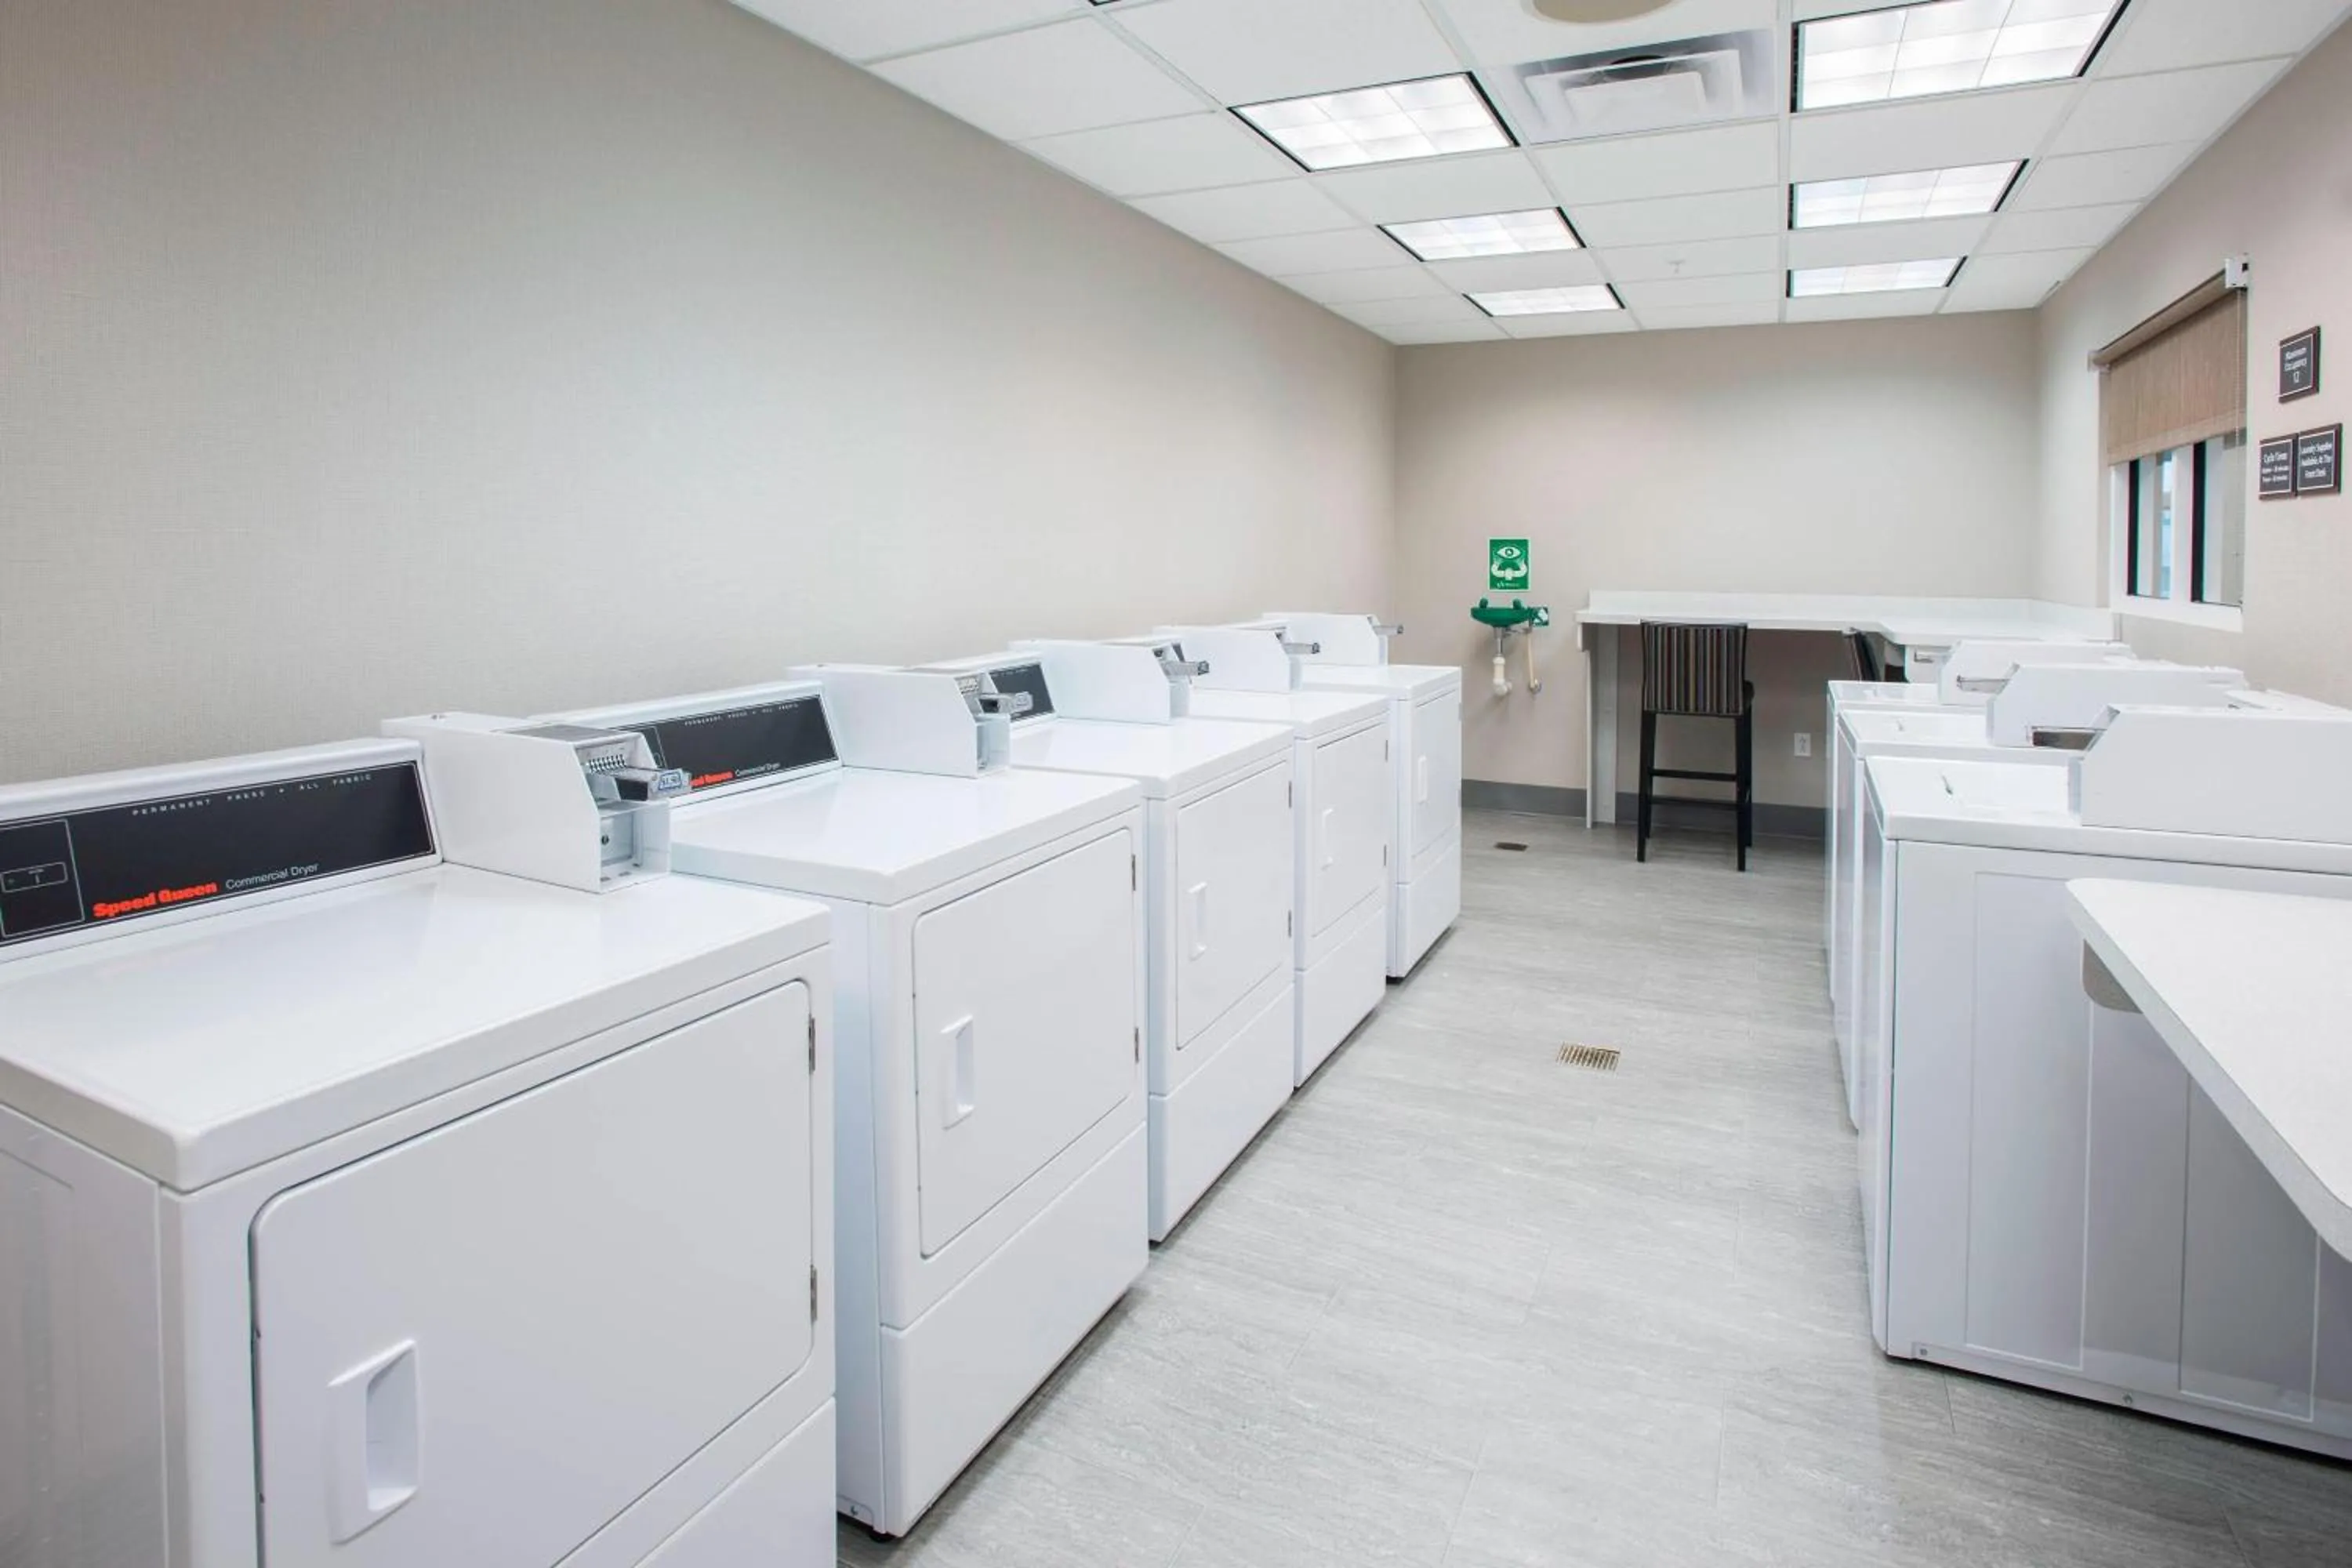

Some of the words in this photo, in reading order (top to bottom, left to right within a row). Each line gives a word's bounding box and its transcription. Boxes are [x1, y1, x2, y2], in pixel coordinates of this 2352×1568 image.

[132, 798, 212, 816] PERMANENT
[227, 789, 266, 801] PRESS
[299, 783, 320, 792] ALL
[332, 774, 372, 787] FABRIC
[93, 892, 155, 917] Speed
[158, 882, 218, 903] Queen
[226, 869, 289, 890] Commercial
[291, 863, 319, 877] Dryer
